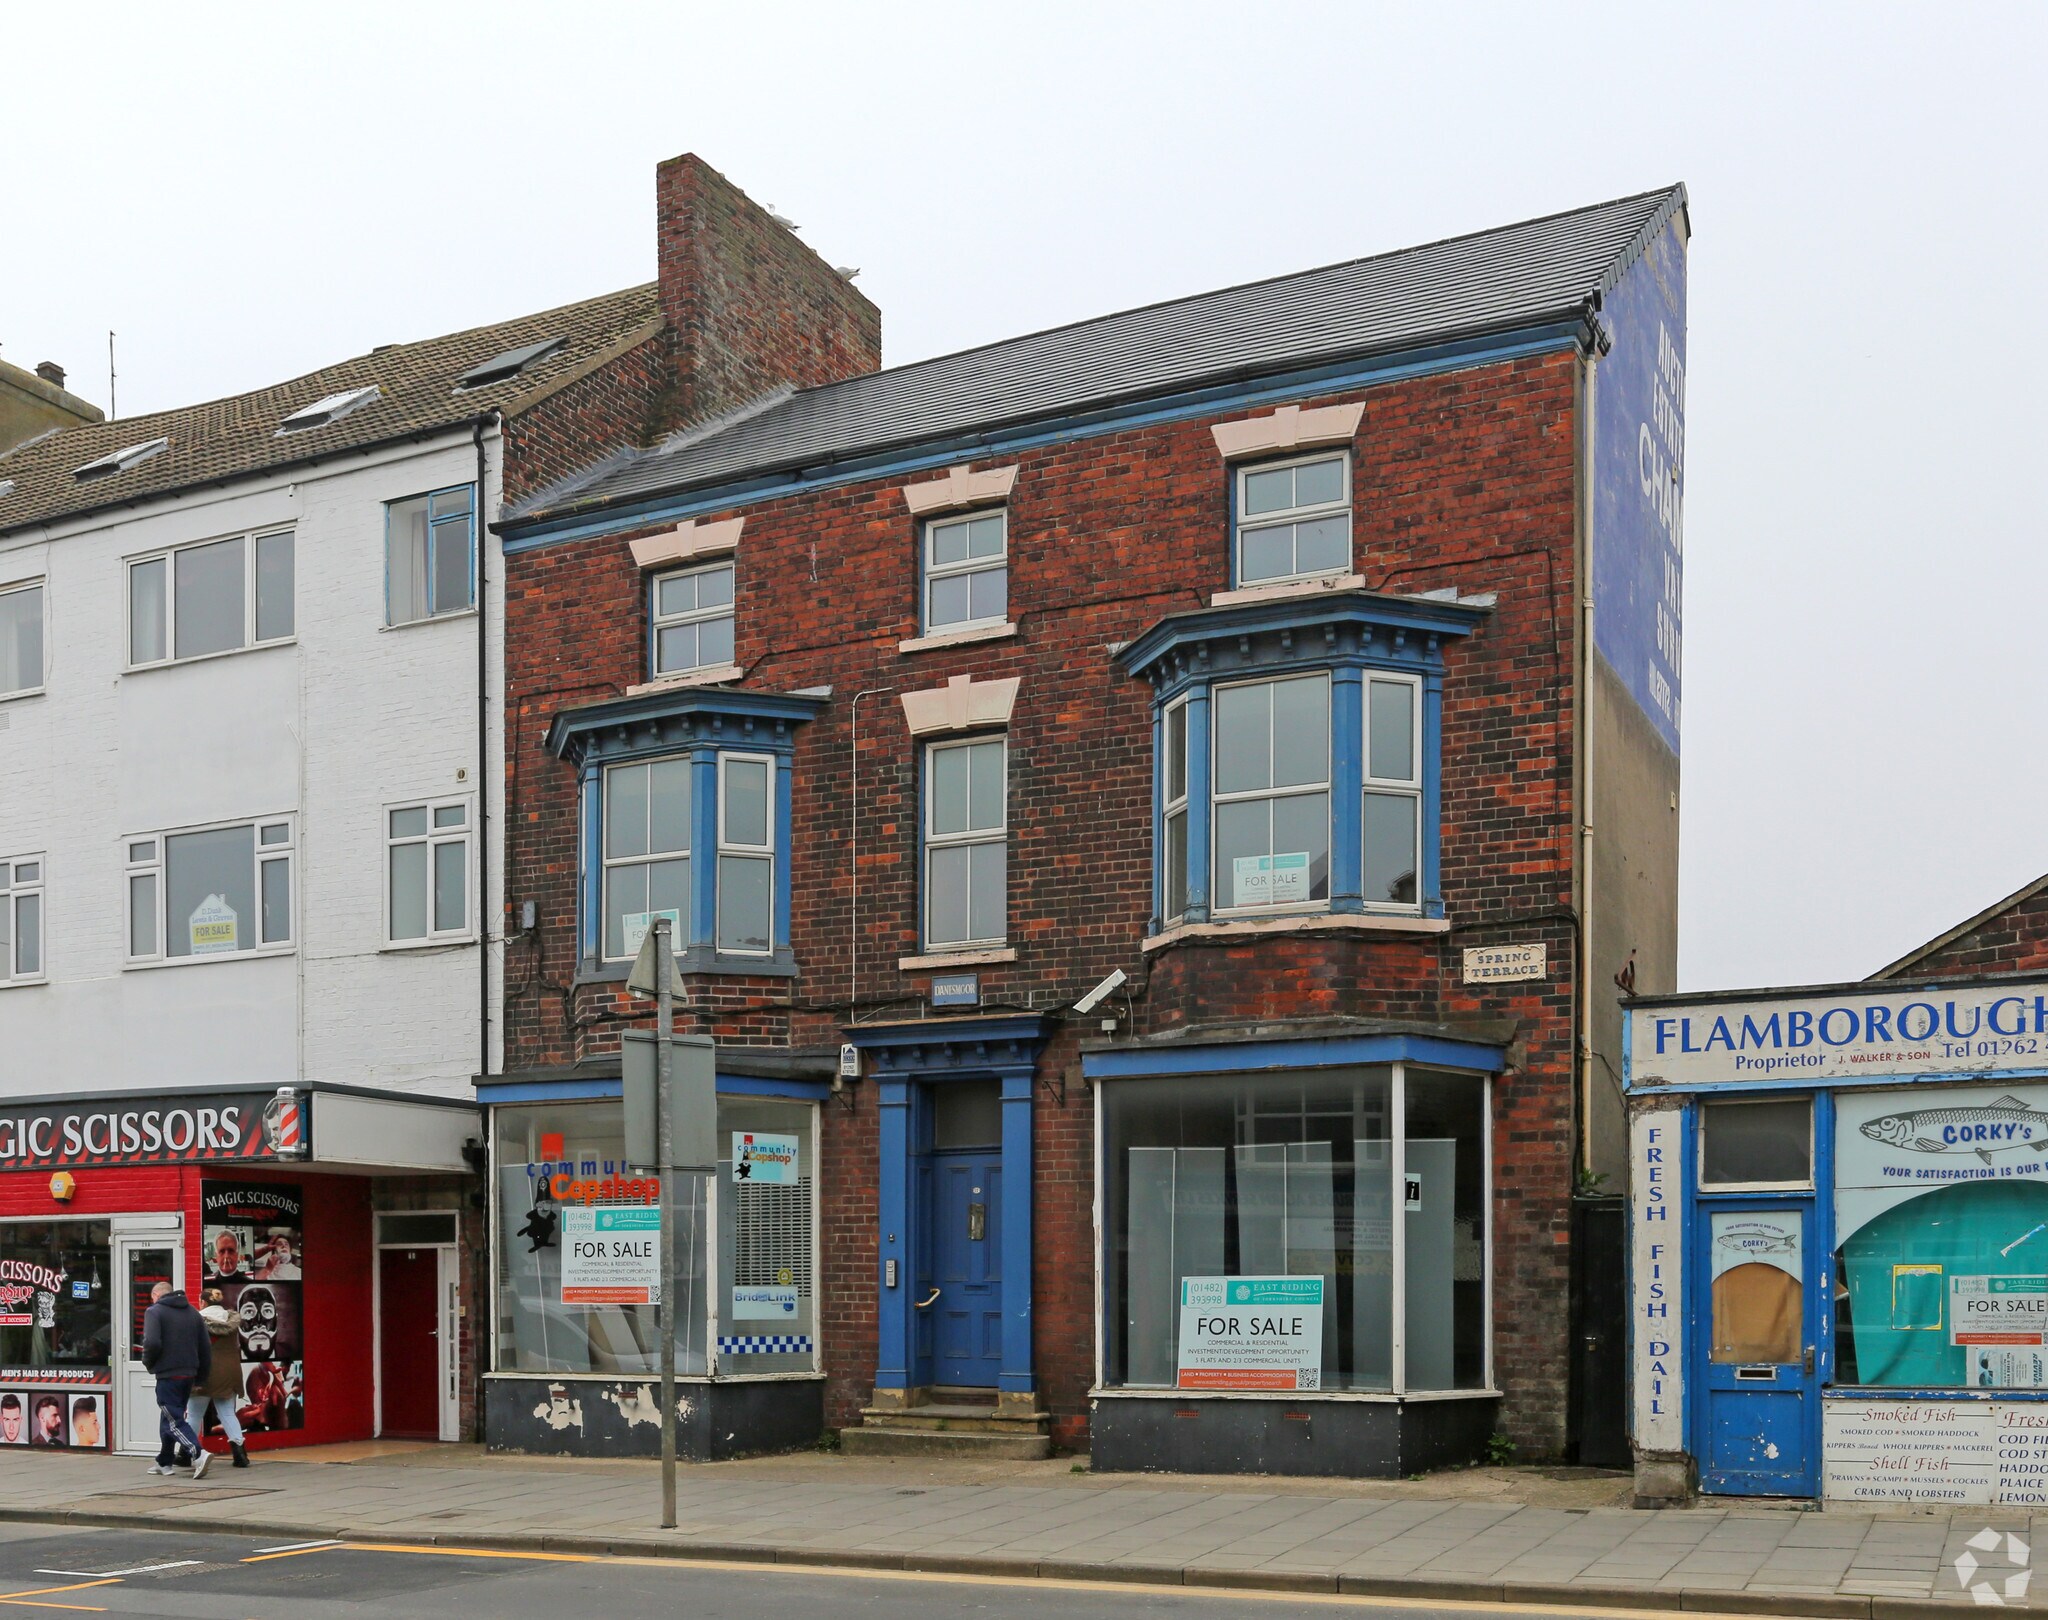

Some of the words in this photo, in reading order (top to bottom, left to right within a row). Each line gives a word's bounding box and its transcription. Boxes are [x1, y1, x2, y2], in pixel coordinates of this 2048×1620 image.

[1653, 371, 1683, 473] ESTATE
[1245, 876, 1267, 886] FOR
[1272, 873, 1297, 884] SALE
[196, 927, 210, 936] FOR
[212, 924, 230, 936] SALE
[1478, 952, 1531, 964] SPRING
[1471, 965, 1538, 977] TERRACE
[1736, 1052, 1826, 1073] Proprietor
[1850, 1053, 1892, 1064] WALKER
[1908, 1051, 1931, 1060] SON
[1942, 1041, 1970, 1058] Tel
[1978, 1038, 2038, 1057] 01262
[62, 1106, 241, 1156] SCISSORS
[1942, 1122, 2032, 1144] CORKY's
[738, 1144, 797, 1156] community
[748, 1151, 791, 1165] Copshop
[1646, 1128, 1666, 1221] FRESH
[1882, 1166, 1910, 1177] YOUR
[1916, 1168, 1995, 1179] SATISFACTION
[2000, 1167, 2012, 1176] IS
[2016, 1164, 2040, 1174] OUR
[550, 1172, 660, 1206] Copshop
[206, 1192, 244, 1210] MAGIC
[247, 1192, 300, 1214] SCISSORS
[574, 1242, 606, 1258] FOR
[613, 1242, 652, 1258] SALE
[1648, 1244, 1666, 1318] FISH
[1190, 1284, 1222, 1293] (01482)
[1191, 1296, 1222, 1304] 393998
[1968, 1301, 2000, 1312] FOR
[2007, 1300, 2045, 1312] SALE
[1198, 1318, 1241, 1335] FOR
[1250, 1318, 1302, 1336] SALE
[2, 1369, 21, 1378] MEN'S
[22, 1370, 39, 1378] HAIR
[40, 1370, 57, 1378] CARE
[59, 1370, 94, 1378] PRODUCTS
[1649, 1341, 1670, 1415] DAIL
[1862, 1407, 1921, 1423] Smoked
[1923, 1408, 1956, 1424] Fish
[2002, 1411, 2048, 1428] Fres
[1999, 1435, 2029, 1444] COD
[1953, 1444, 1994, 1452] MACKEREL
[1999, 1449, 2029, 1458] COD
[1870, 1455, 1910, 1470] Shell
[1914, 1456, 1950, 1472] Fish
[1999, 1464, 2048, 1474] HADDO
[1831, 1474, 1865, 1482] PRAWNS
[2000, 1478, 2044, 1488] PLAICE
[1854, 1488, 1886, 1496] CRABS
[1890, 1488, 1912, 1497] AND
[1916, 1490, 1966, 1498] LOBSTERS
[2000, 1493, 2047, 1503] LEMON
